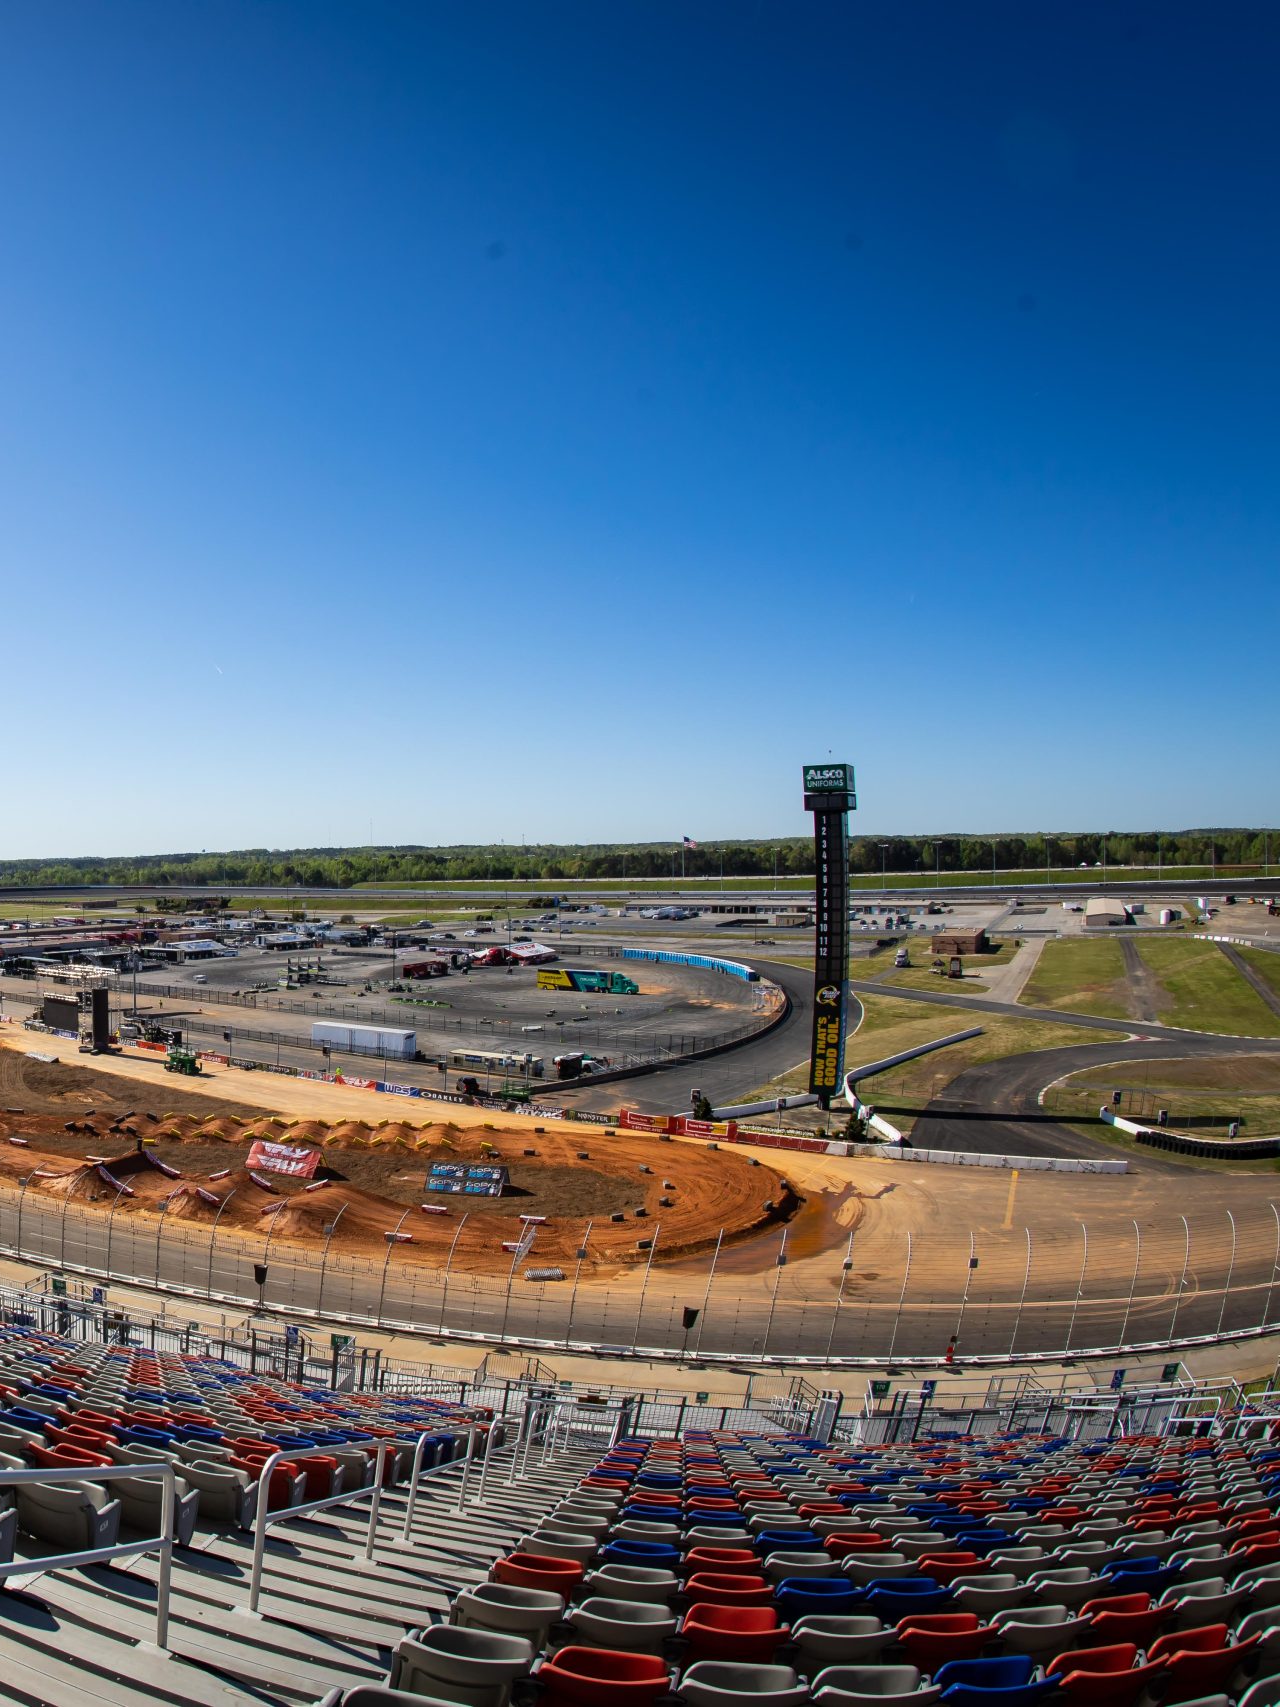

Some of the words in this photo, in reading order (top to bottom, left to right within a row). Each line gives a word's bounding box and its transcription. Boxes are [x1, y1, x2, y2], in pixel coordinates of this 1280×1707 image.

[806, 769, 844, 780] ALSCO
[807, 779, 844, 788] UNIFORMS
[819, 923, 828, 932] 10
[819, 936, 828, 945] 11
[819, 947, 828, 956] 12
[816, 1016, 827, 1055] THAT'S
[824, 1047, 838, 1087] GOOD
[814, 1059, 825, 1086] NOW
[432, 1093, 464, 1103] OAKLEY
[577, 1112, 609, 1122] MONSTER
[429, 1178, 461, 1186] GoPro
[466, 1181, 498, 1189] GoPro
